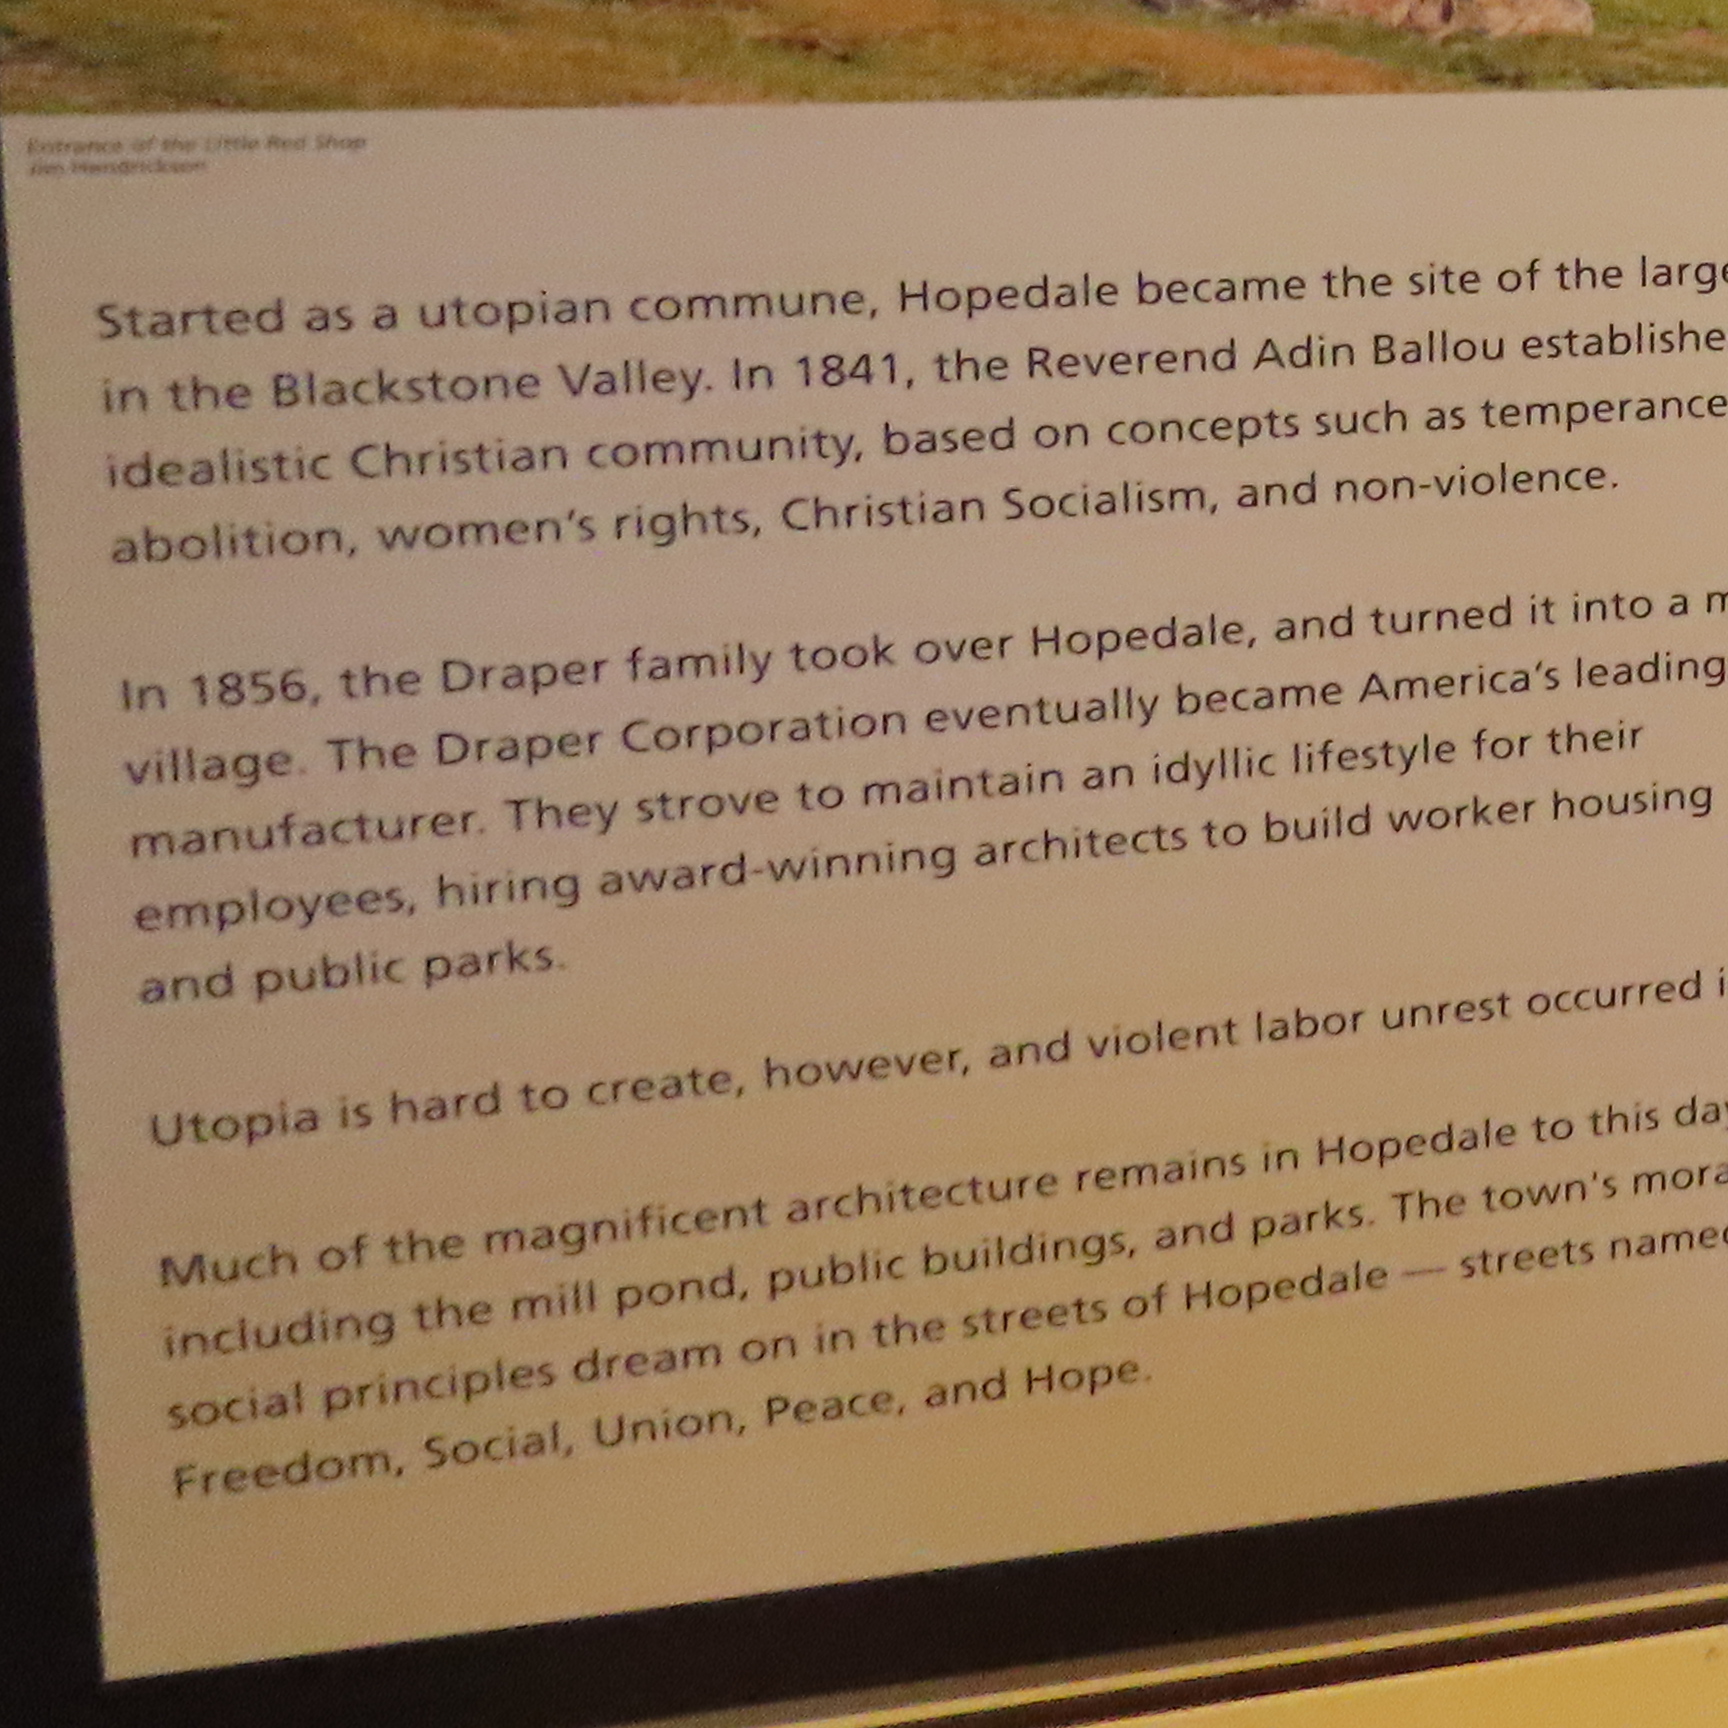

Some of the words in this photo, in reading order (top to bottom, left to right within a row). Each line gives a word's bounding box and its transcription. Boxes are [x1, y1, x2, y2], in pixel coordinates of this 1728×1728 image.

[95, 297, 285, 341] Started
[303, 305, 355, 334] as
[372, 303, 398, 332] a
[418, 290, 612, 336] utopian
[628, 289, 879, 323] commune,
[898, 272, 1119, 321] Hopedale
[1136, 270, 1307, 306] became
[1321, 265, 1394, 300] the
[1408, 262, 1482, 298] site
[1497, 257, 1541, 294] of
[1554, 256, 1624, 291] the
[107, 447, 332, 490] idealistic
[348, 438, 568, 480] Christian
[585, 425, 864, 469] community,
[882, 415, 1016, 457] based
[1032, 421, 1091, 450] on
[1106, 408, 1300, 448] concepts
[1314, 399, 1409, 438] such
[1424, 405, 1466, 432] as
[129, 810, 485, 859] manufacturer.
[503, 797, 619, 836] They
[635, 788, 780, 825] strove
[796, 782, 845, 812] to
[862, 762, 1064, 807] maintain
[1081, 763, 1134, 791] an
[1152, 746, 1276, 792] idyllic
[1292, 732, 1456, 777] lifestyle
[1472, 727, 1533, 762] for
[1546, 719, 1644, 756] their
[159, 1243, 298, 1288] Much
[316, 1233, 368, 1273] of
[383, 1229, 465, 1266] the
[483, 1197, 769, 1257] magnificent
[786, 1172, 1059, 1225] architecture
[1075, 1151, 1247, 1193] remains
[1263, 1142, 1300, 1173] in
[1317, 1117, 1517, 1169] Hopedale
[1531, 1116, 1575, 1144] to
[1588, 1102, 1660, 1137] this
[164, 1309, 396, 1358] including
[412, 1295, 493, 1333] the
[511, 1280, 597, 1321] mill
[615, 1264, 748, 1319] pond,
[768, 1250, 906, 1301] public
[921, 1230, 1137, 1277] buildings,
[1154, 1210, 1235, 1251] and
[1251, 1199, 1375, 1249] parks.
[1391, 1189, 1467, 1223] The
[173, 1450, 404, 1499] Freedom,
[423, 1420, 573, 1470] Social,
[593, 1408, 746, 1449] Union,
[765, 1390, 906, 1427] Peace,
[924, 1366, 1007, 1409] and
[1024, 1360, 1150, 1397] Hope.
